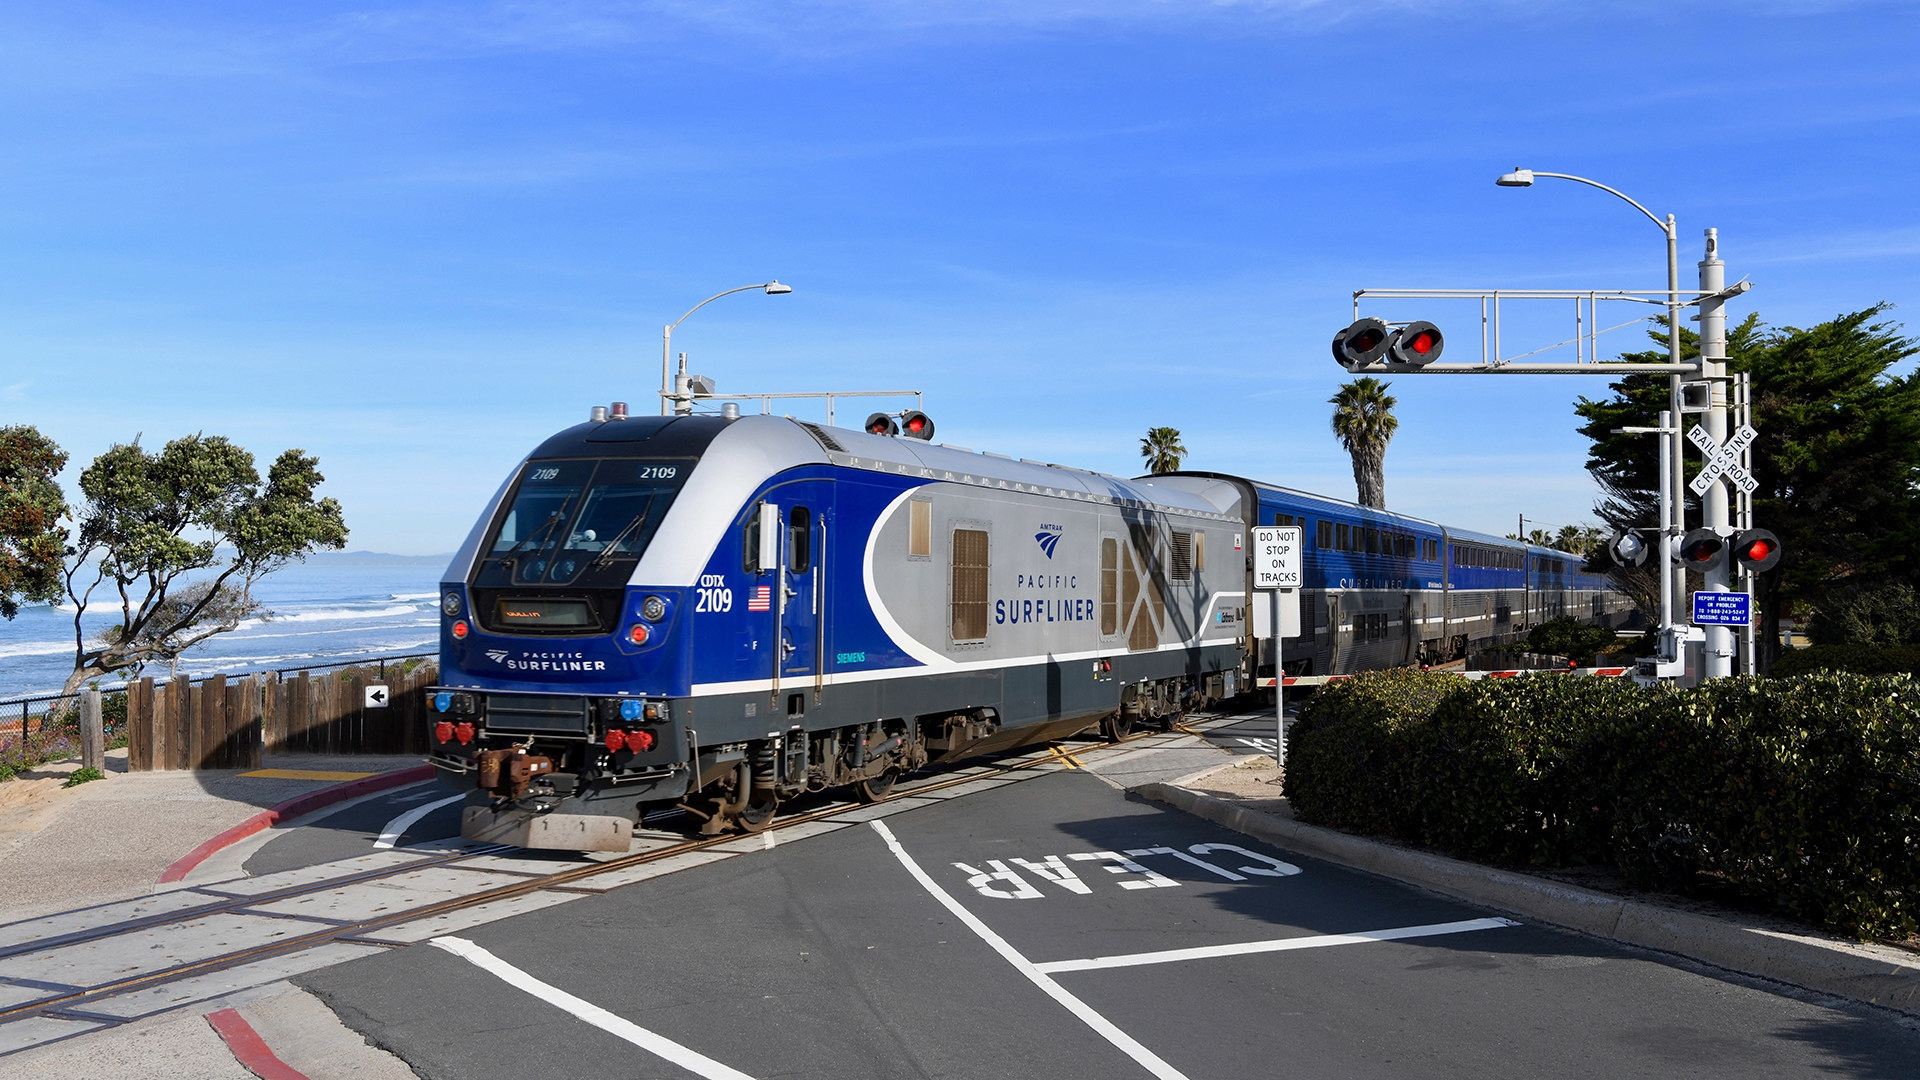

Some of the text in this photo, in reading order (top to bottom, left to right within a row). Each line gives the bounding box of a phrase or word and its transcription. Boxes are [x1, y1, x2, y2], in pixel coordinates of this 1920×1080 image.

[1691, 428, 1755, 491] RAIL ROAD
[1696, 429, 1752, 490] CROSSING
[531, 468, 560, 480] 2109
[640, 467, 676, 479] 2109
[1040, 523, 1063, 531] AMTRAK
[1260, 532, 1295, 541] DO NOT
[1266, 545, 1290, 555] STOP
[1272, 559, 1285, 569] ON
[701, 574, 725, 587] CDTX
[1018, 574, 1076, 589] PACIFIC
[1260, 572, 1297, 582] TRACKS
[695, 588, 733, 613] 2109
[995, 599, 1094, 624] SURFLINER
[752, 640, 758, 650] F
[836, 651, 866, 664] SIEMENS
[507, 659, 606, 671] SURFLINER
[950, 843, 1303, 899] CLEAR
